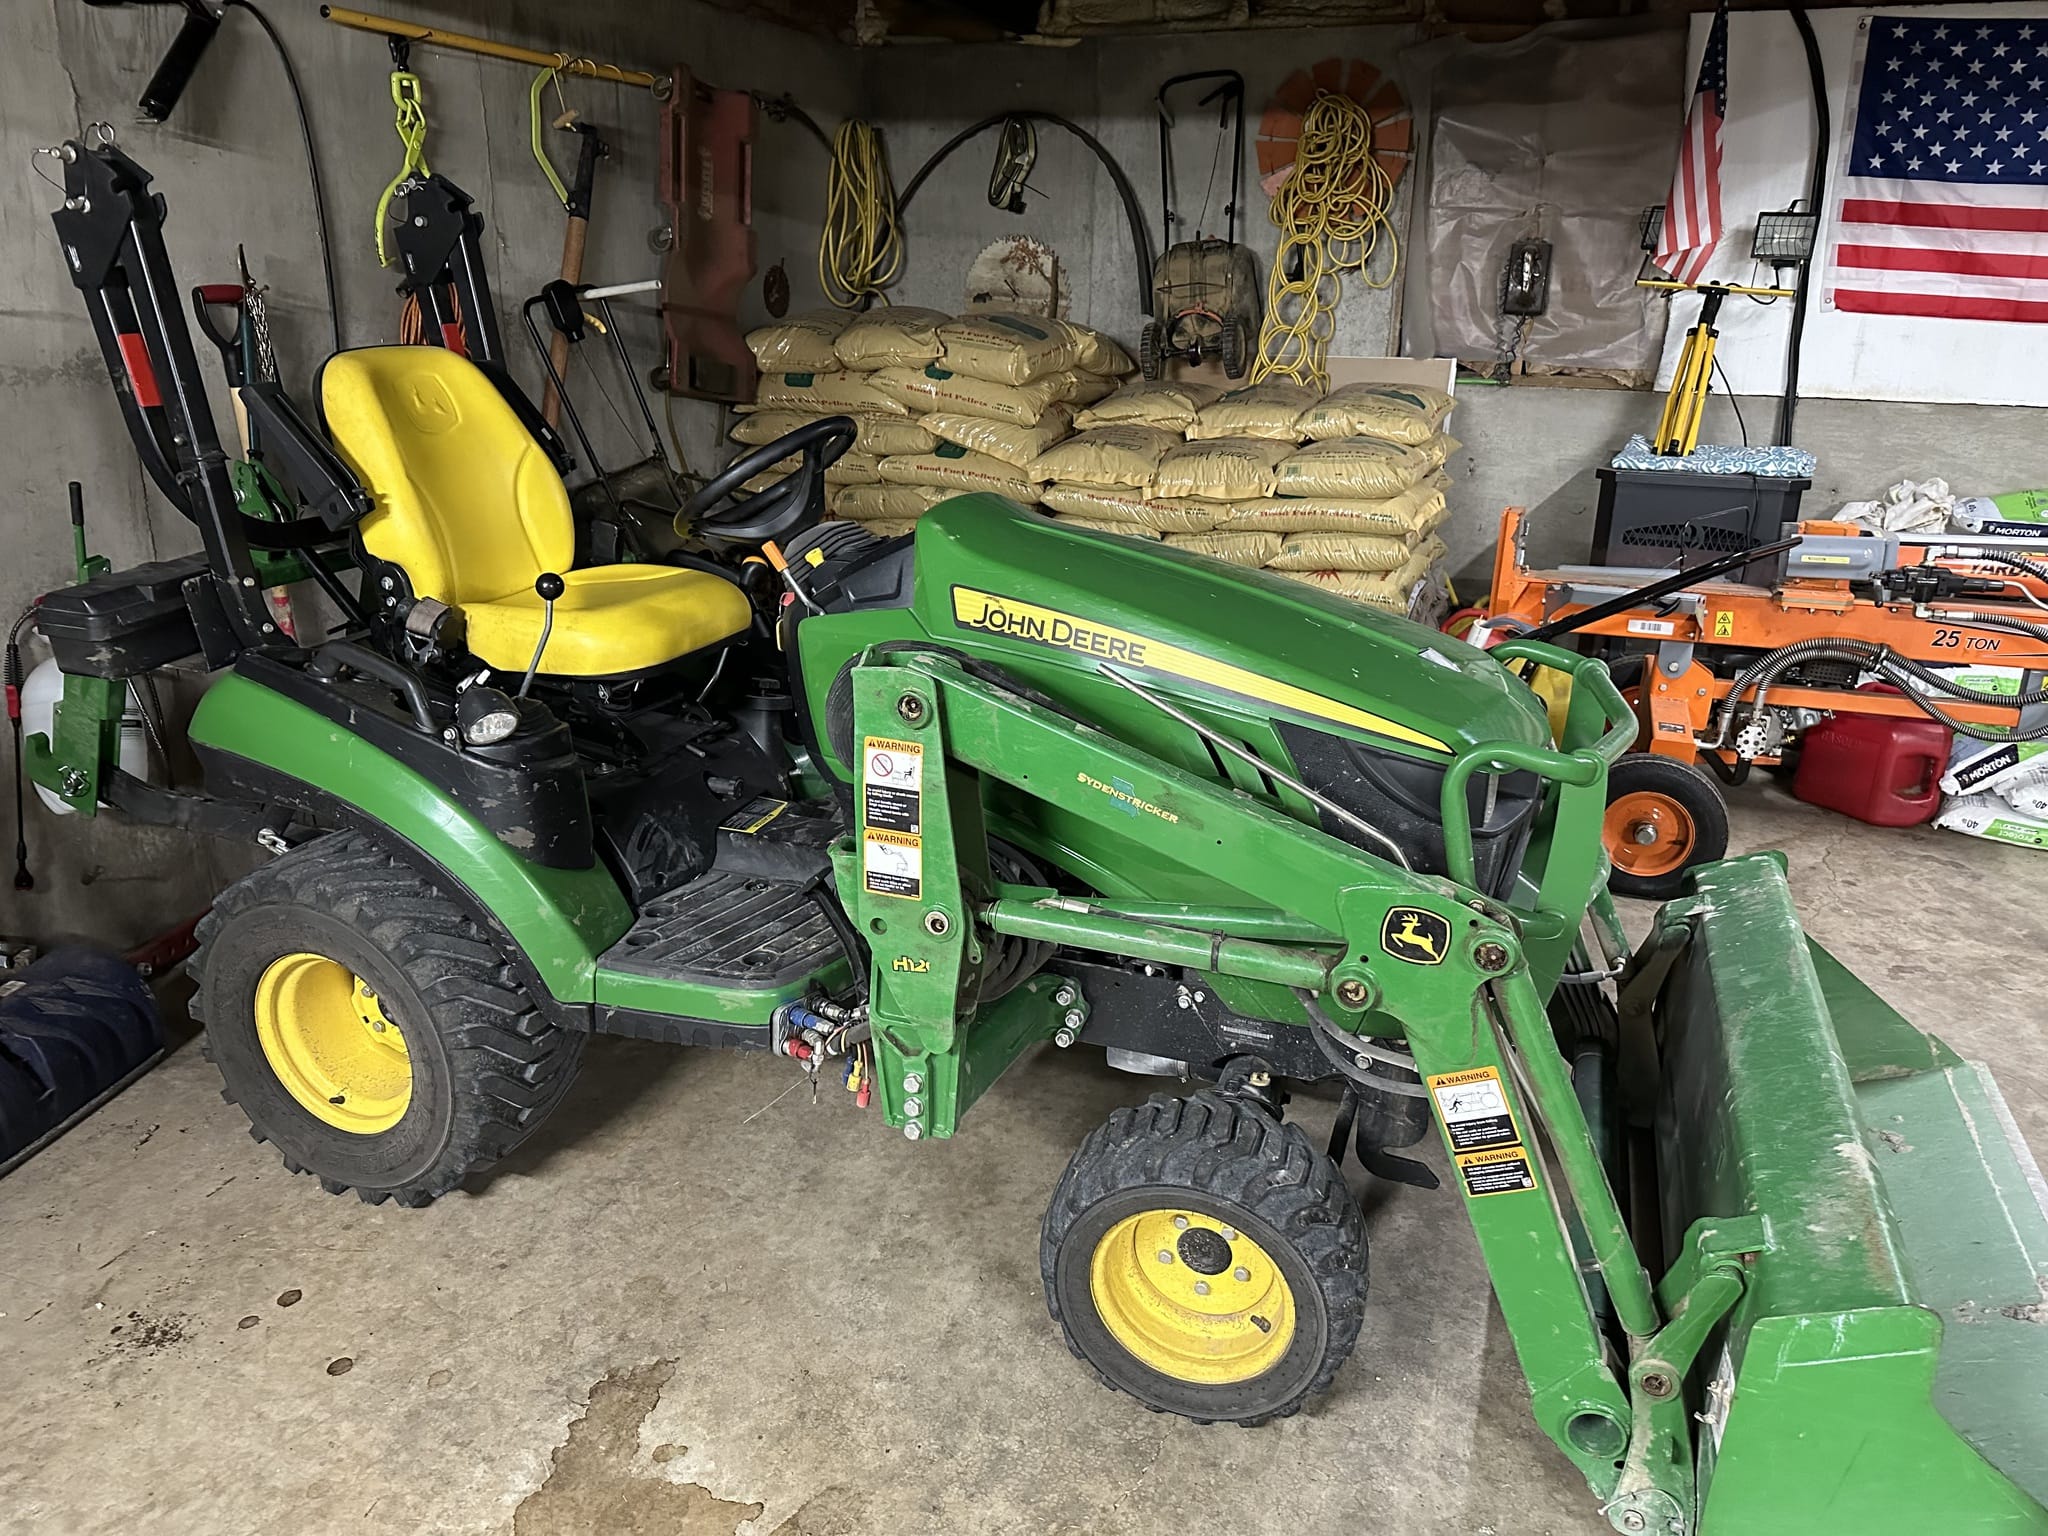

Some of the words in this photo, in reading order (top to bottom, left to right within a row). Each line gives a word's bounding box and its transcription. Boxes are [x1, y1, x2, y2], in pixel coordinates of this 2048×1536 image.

[916, 464, 941, 472] Wood
[943, 467, 965, 475] Fuel
[968, 471, 1001, 481] Pellets
[1995, 527, 2041, 537] MORTON
[973, 603, 1045, 638] JOHN
[1051, 618, 1146, 664] DEERE
[1931, 629, 1962, 647] 25
[1966, 637, 2000, 650] TON
[876, 740, 921, 754] WARNING
[1969, 755, 2012, 781] MORTON
[1077, 772, 1179, 824] SYDENSTRICKER
[875, 833, 919, 847] WARNING
[1446, 1071, 1490, 1084] WARNING
[1475, 1151, 1519, 1163] WARNING
